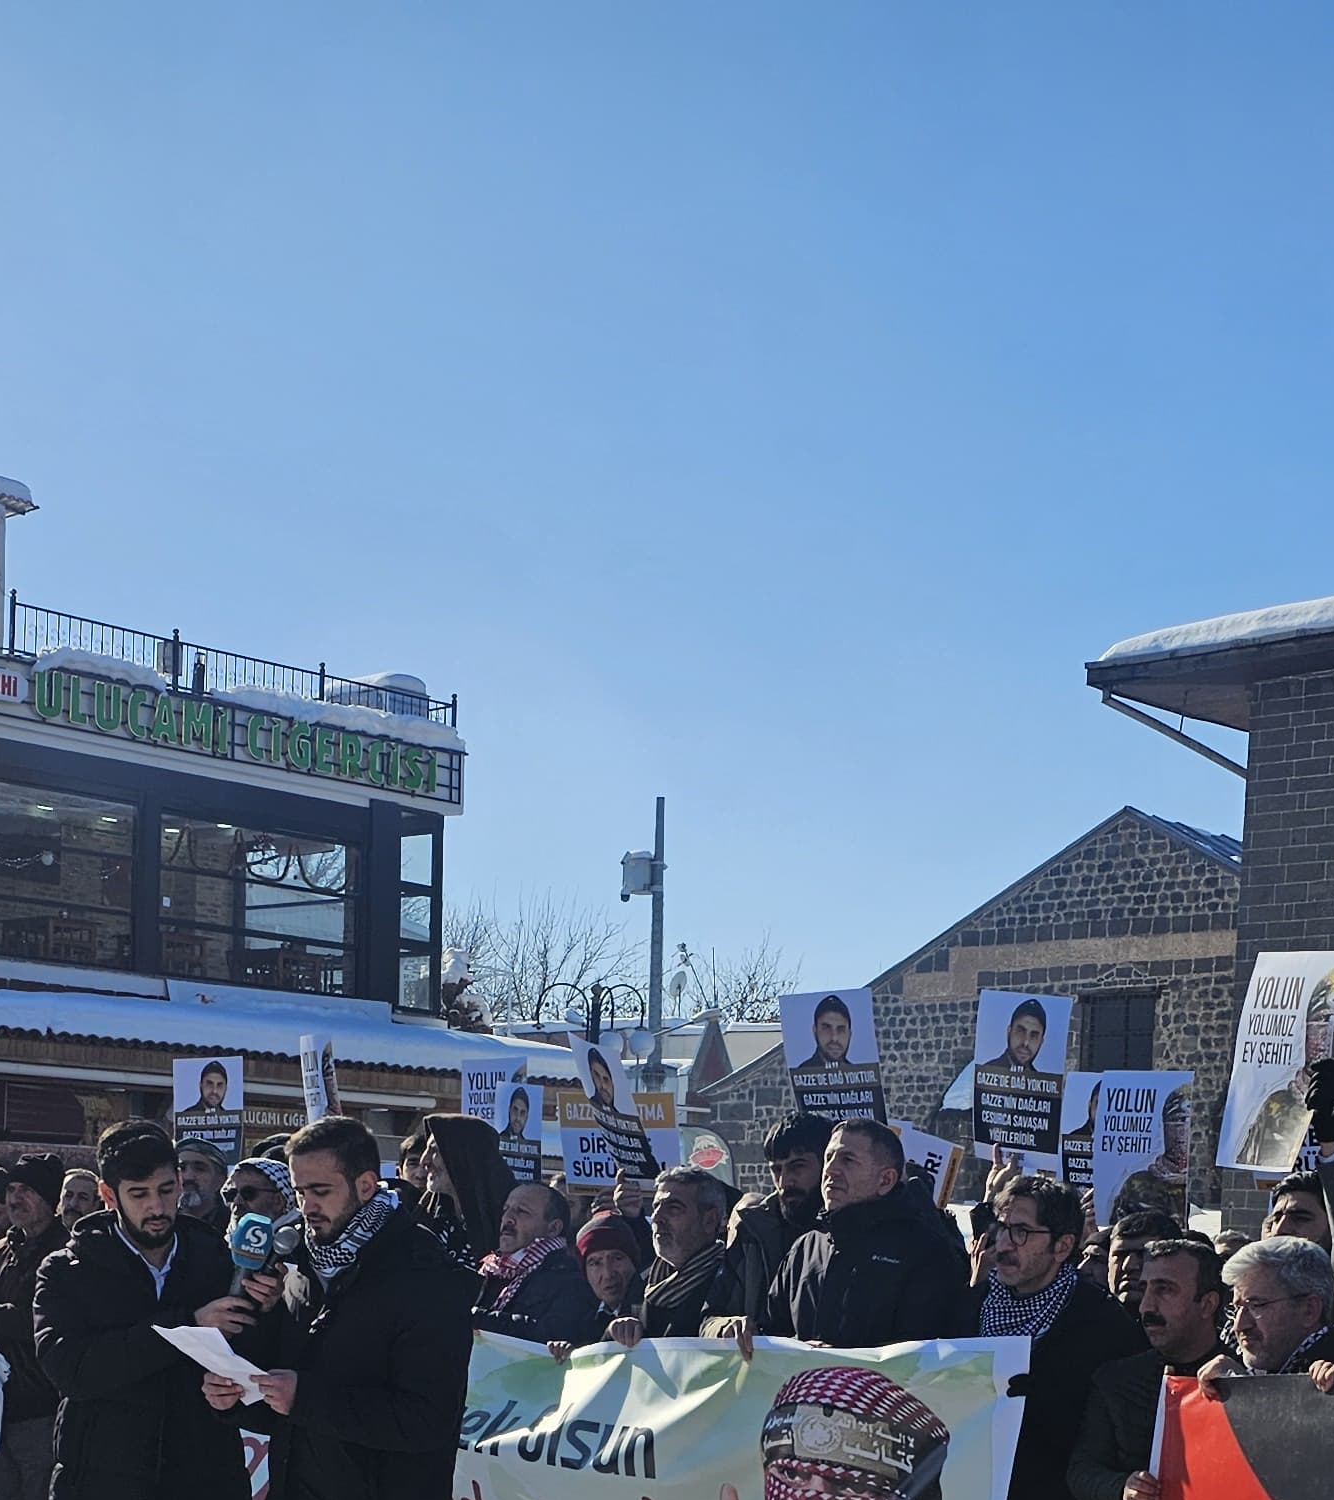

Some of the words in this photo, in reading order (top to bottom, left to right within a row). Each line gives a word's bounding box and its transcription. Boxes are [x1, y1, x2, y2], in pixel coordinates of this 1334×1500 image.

[35, 671, 228, 754] ULUCAMİ
[247, 713, 437, 793] CİĞERCİSİ
[1253, 976, 1306, 1011] YOLUN
[1248, 1014, 1297, 1037] YOLUMUZ
[1242, 1041, 1255, 1065] EY
[1257, 1038, 1293, 1069] ŞEHİT!
[793, 1073, 827, 1087] GAZZE'DE
[828, 1071, 844, 1085] DAĞ
[976, 1071, 1009, 1088] GAZZE'DE
[1010, 1074, 1026, 1090] DAĞ
[1026, 1078, 1060, 1094] YOKTUR.
[468, 1091, 496, 1106] YOLUM
[841, 1090, 874, 1105] DAĞLARI
[1017, 1097, 1052, 1114] DAĞLARI
[1107, 1088, 1156, 1114] YOLUN
[1012, 1115, 1049, 1131] SAVAŞAN
[1103, 1115, 1153, 1134] YOLUMUZ
[1101, 1136, 1114, 1151] EY
[1116, 1135, 1152, 1154] ŞEHİT!
